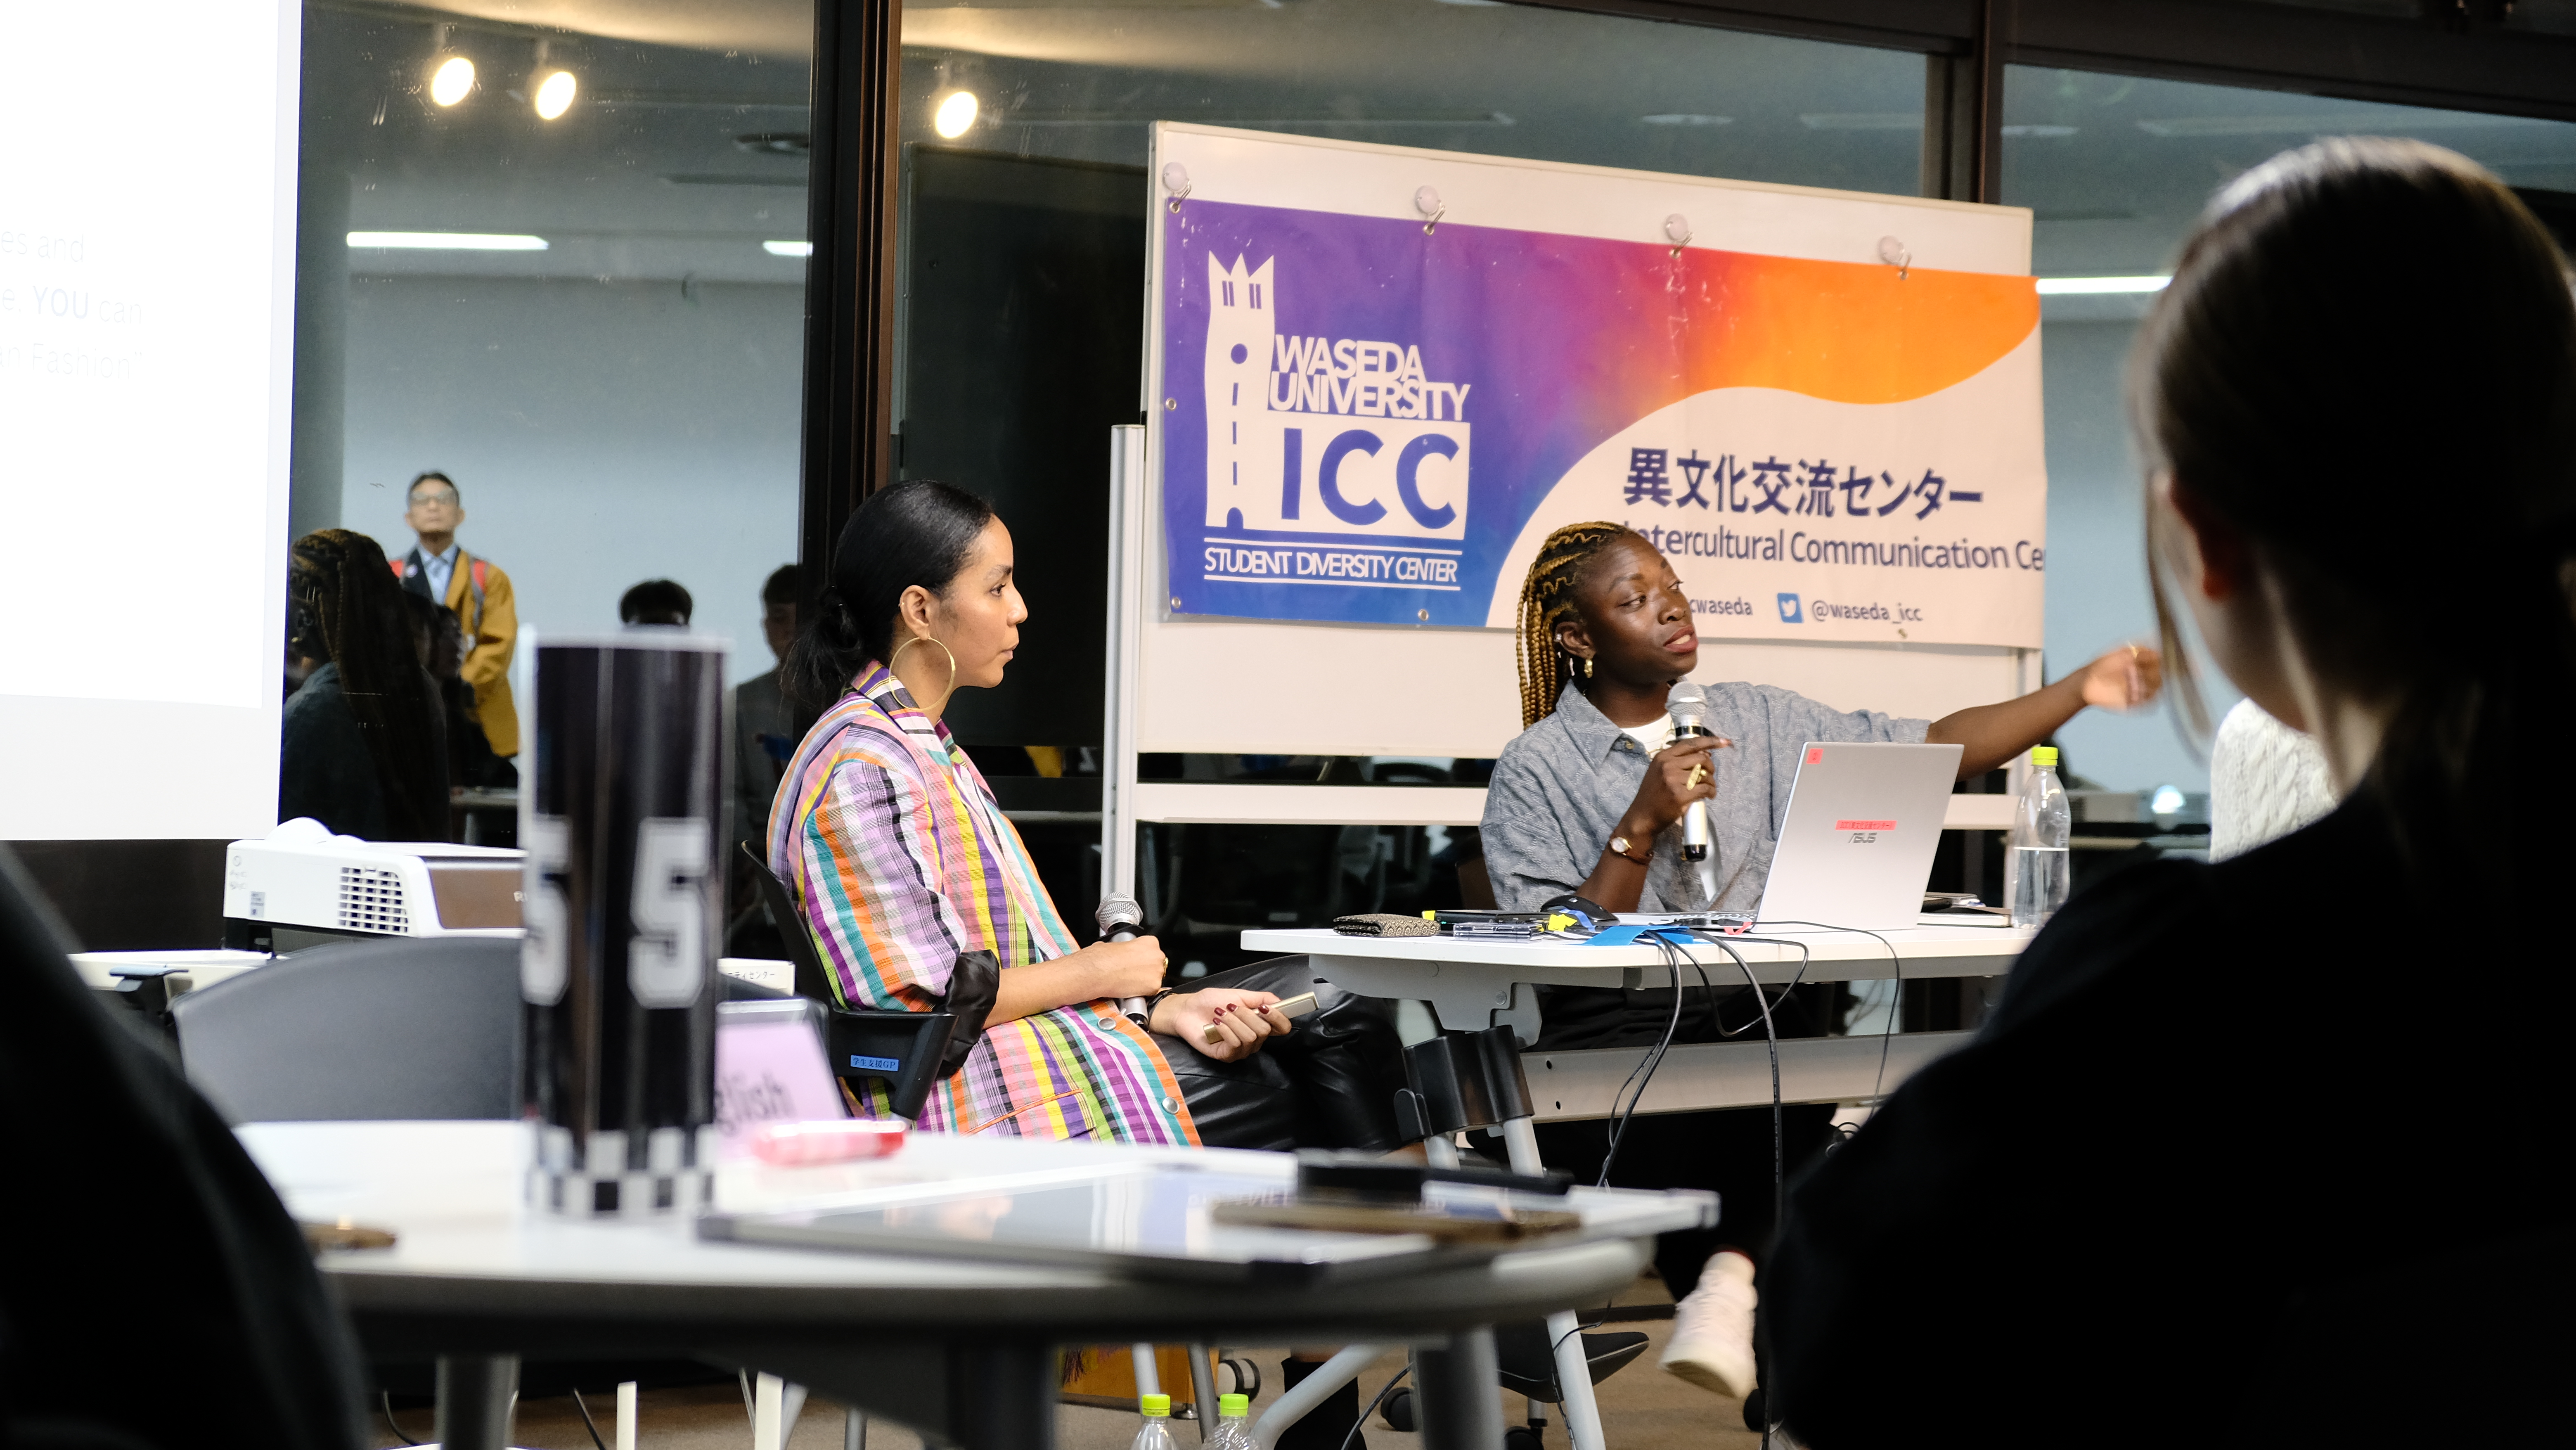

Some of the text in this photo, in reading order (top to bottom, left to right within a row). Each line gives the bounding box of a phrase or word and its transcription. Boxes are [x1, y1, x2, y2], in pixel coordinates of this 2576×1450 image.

[38, 234, 83, 263] and
[33, 286, 88, 319] YOU
[99, 301, 142, 324] can
[1275, 334, 1426, 382] WASEDA
[1269, 371, 1470, 421] UNIVERSITY
[1281, 427, 1460, 530] ICC
[1624, 447, 1984, 521] 異文化交流センター
[1204, 547, 1457, 583] STUDENT DIVERSITY CENTER
[1625, 521, 1784, 562] tercultural
[1791, 532, 2010, 569] Communication
[1811, 600, 1924, 624] @waseda_icc
[1848, 832, 1877, 843] ASUS
[627, 816, 710, 1009] 5
